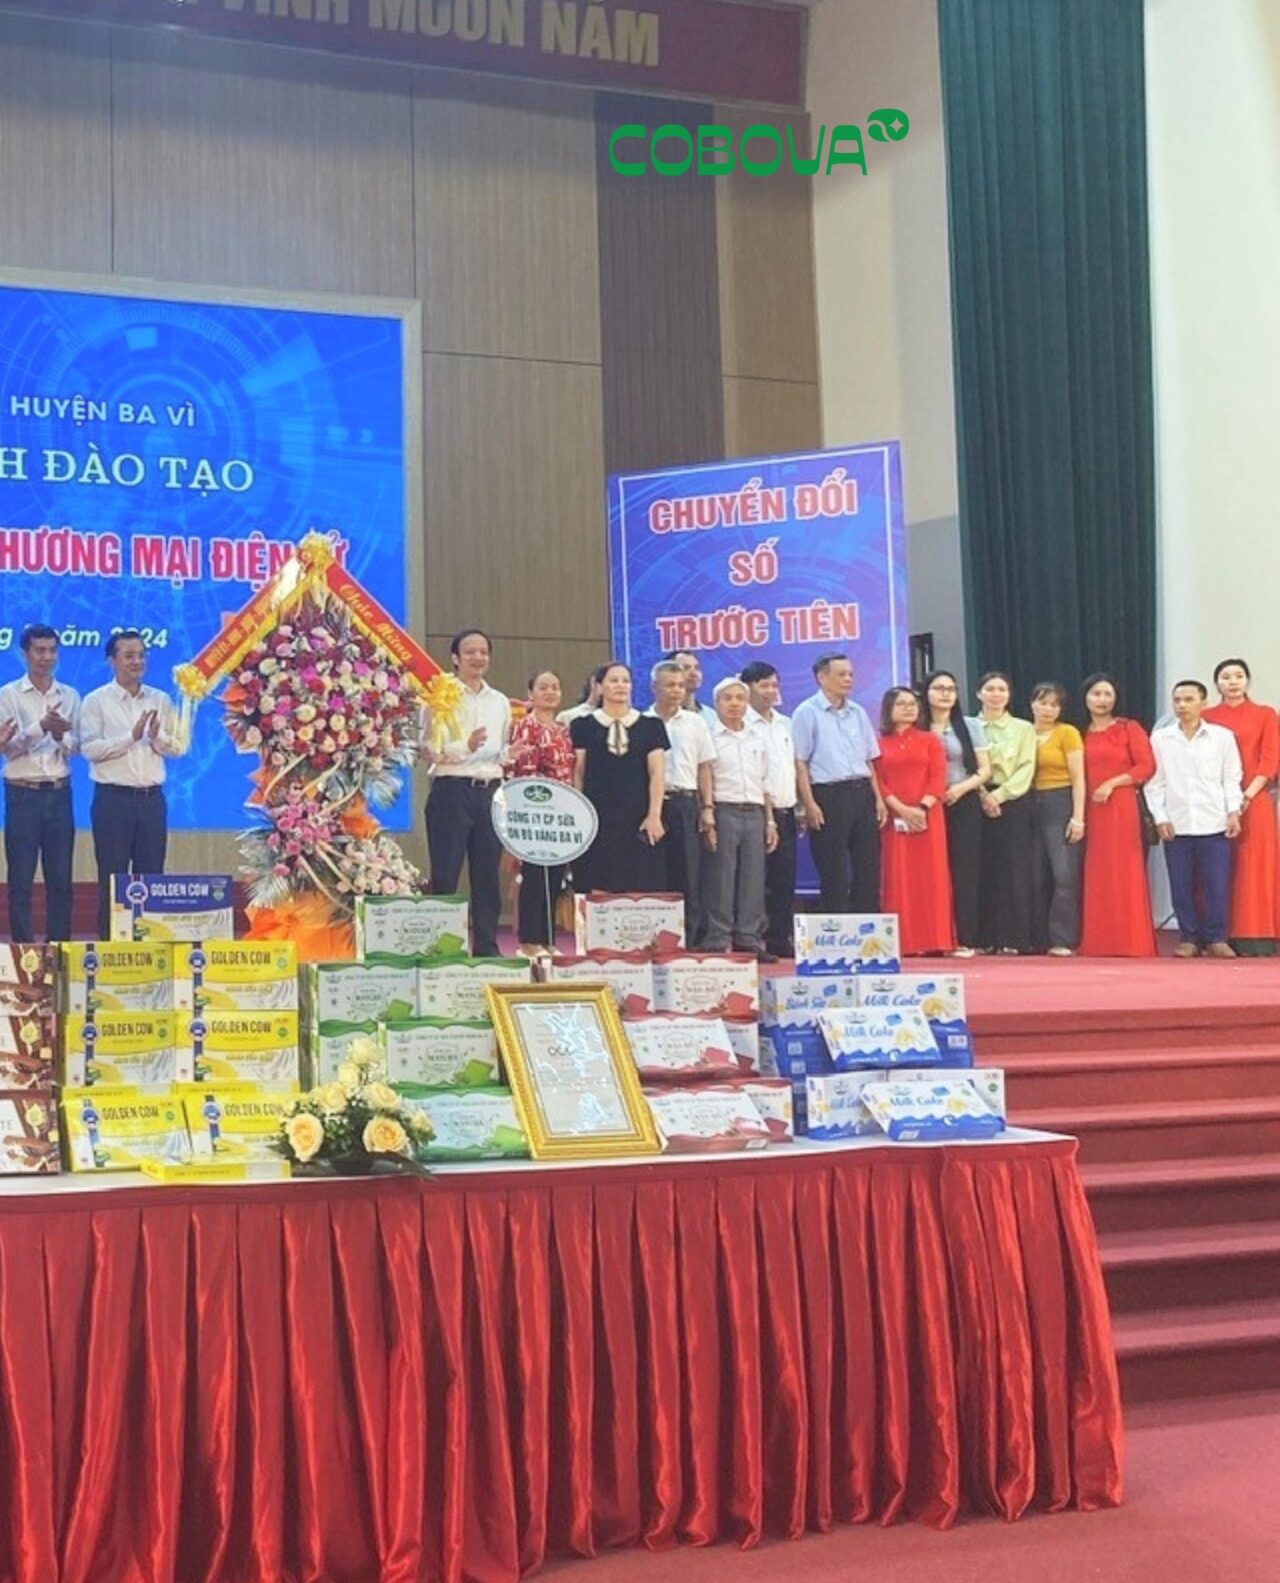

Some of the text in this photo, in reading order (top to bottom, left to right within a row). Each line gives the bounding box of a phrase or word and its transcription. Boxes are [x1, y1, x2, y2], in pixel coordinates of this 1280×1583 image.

[11, 394, 107, 428] HUYỆN
[119, 404, 157, 425] BA
[167, 403, 196, 427] VÌ
[43, 443, 145, 485] ĐÀO
[160, 457, 254, 498] TẠO
[649, 468, 859, 534] CHUYỂN ĐỔI
[132, 536, 202, 589] MẠI
[729, 538, 780, 586] SỐ
[656, 600, 860, 653] TRƯỚC TIÊN
[150, 883, 187, 897] GOLDEN
[211, 1020, 248, 1034] GOLDEN
